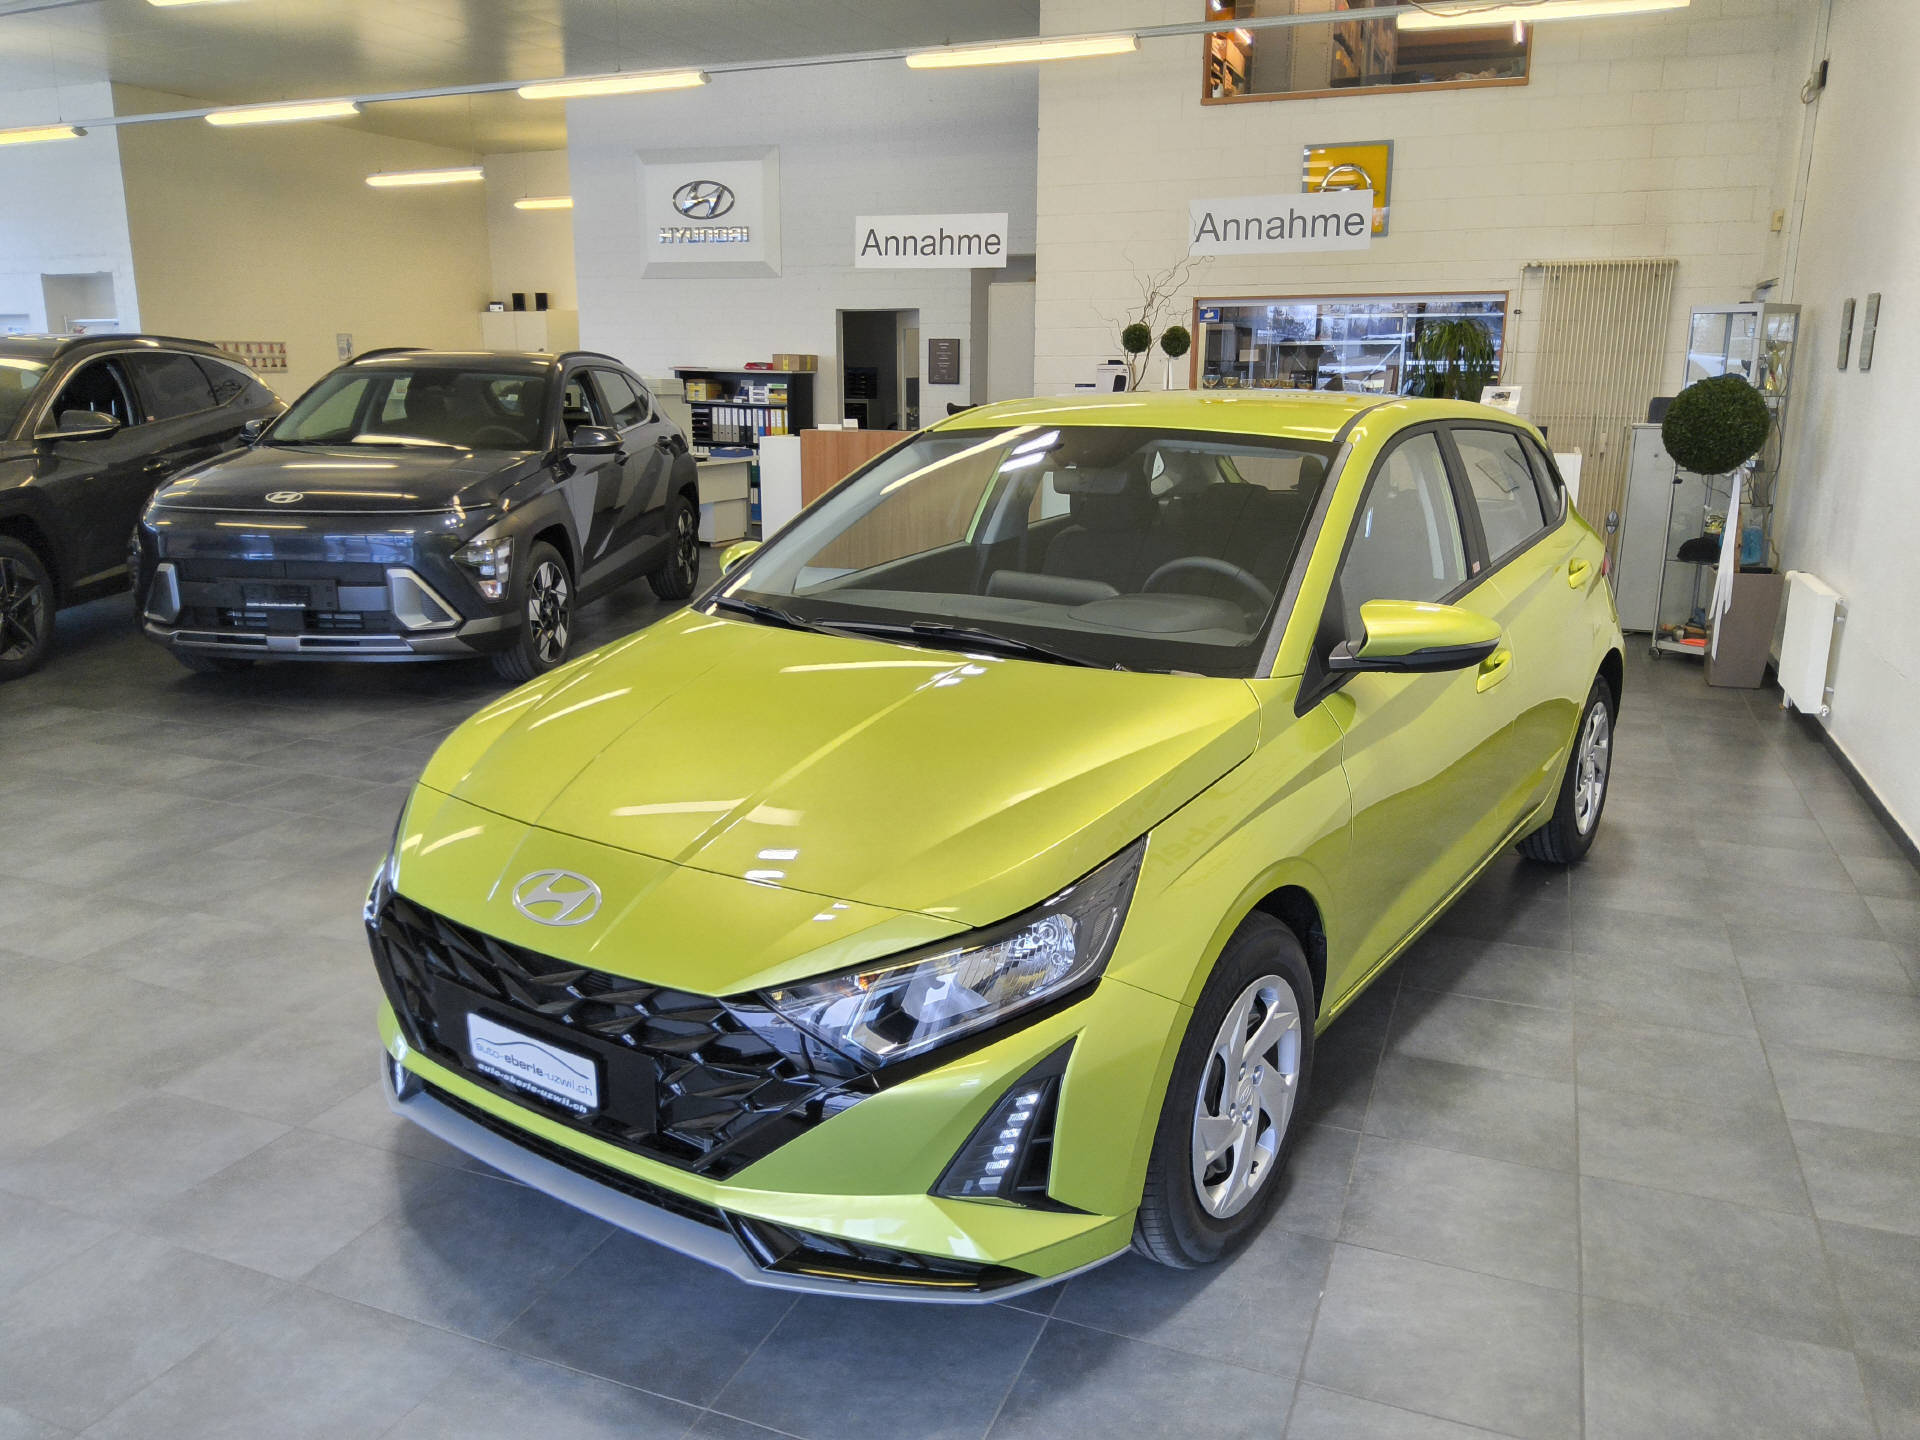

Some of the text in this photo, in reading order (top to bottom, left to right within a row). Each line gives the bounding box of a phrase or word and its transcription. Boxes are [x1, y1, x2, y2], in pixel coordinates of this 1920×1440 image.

[659, 226, 750, 243] HYUNDAI
[861, 227, 1001, 257] Annahme
[1195, 208, 1364, 243] Annahme
[475, 1042, 593, 1097] auto-eberle-uzwil.ch
[477, 1063, 587, 1114] auto-eberle-uzwil.ch
